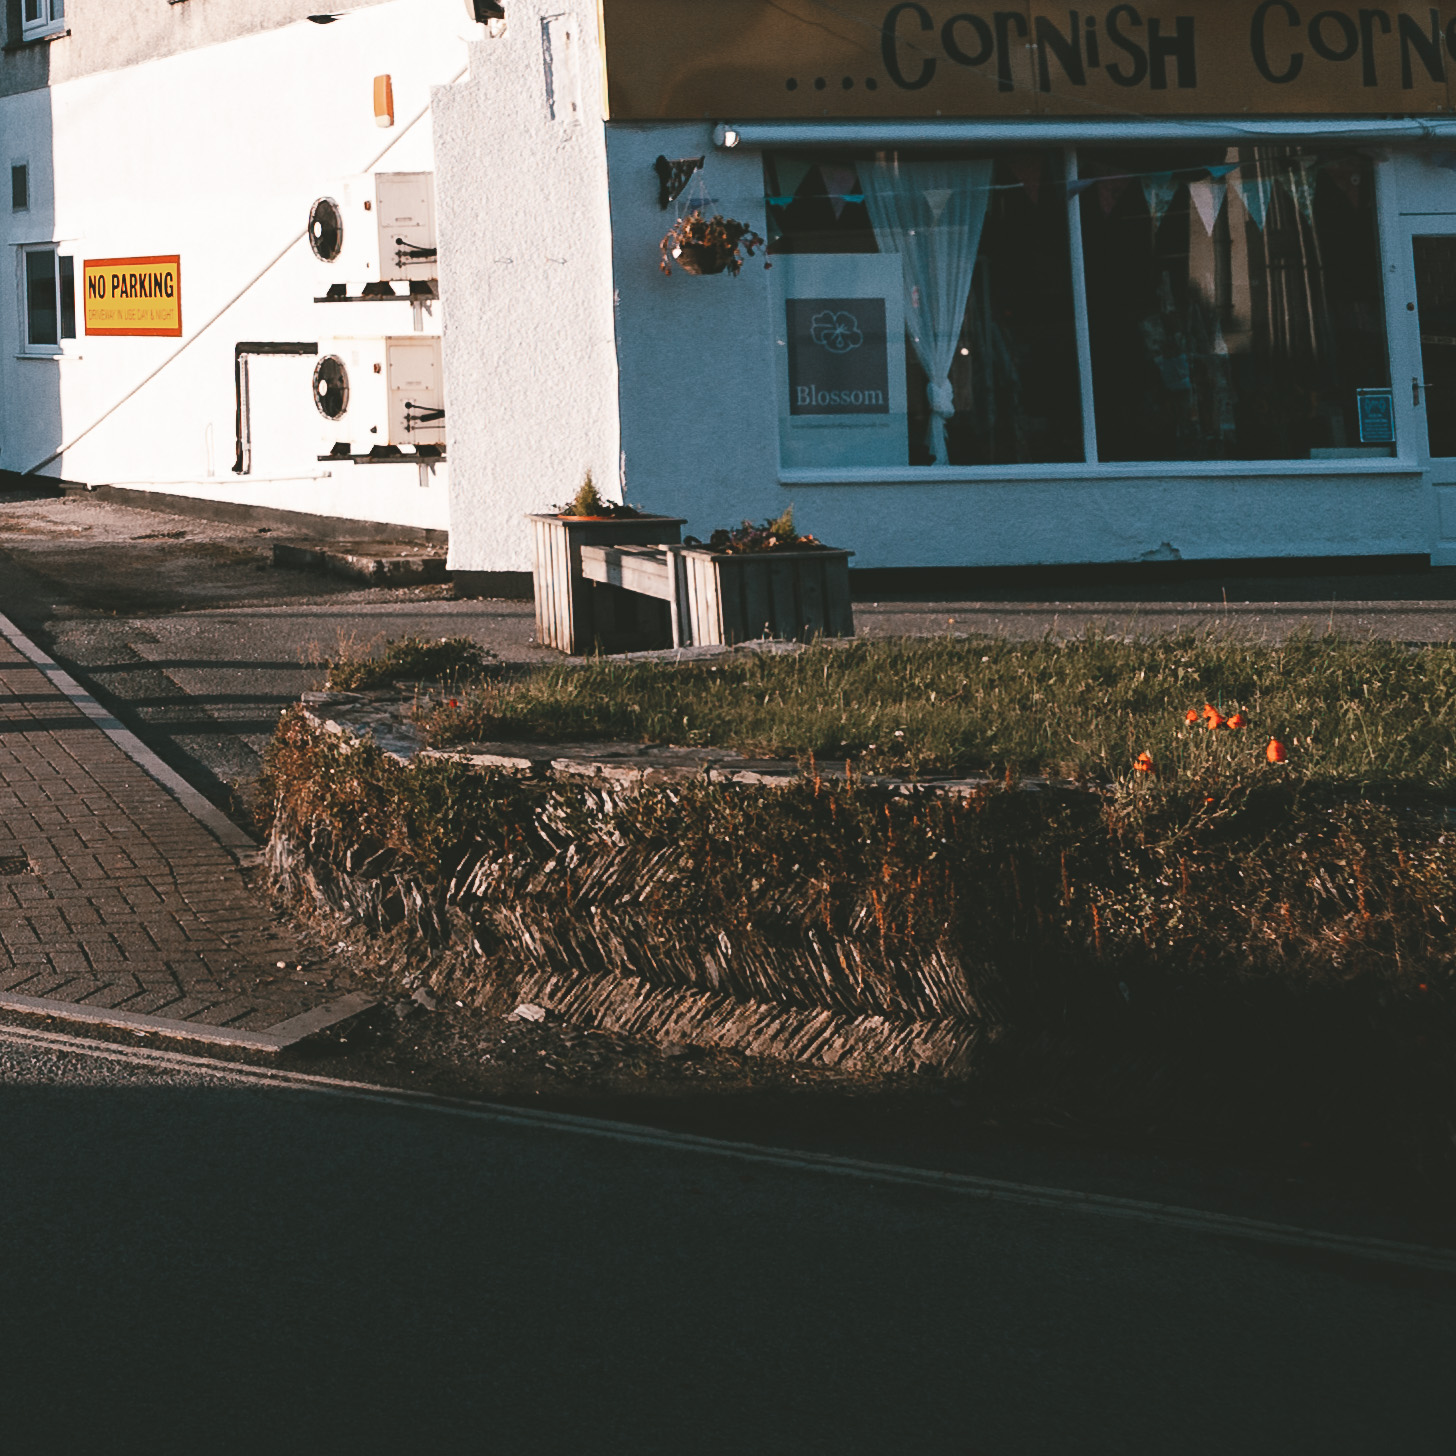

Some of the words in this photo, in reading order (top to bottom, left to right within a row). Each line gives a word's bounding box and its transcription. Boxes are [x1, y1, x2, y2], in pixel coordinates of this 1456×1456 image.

[89, 275, 106, 299] NO
[111, 271, 174, 298] PARKING
[796, 384, 884, 406] Blossom
